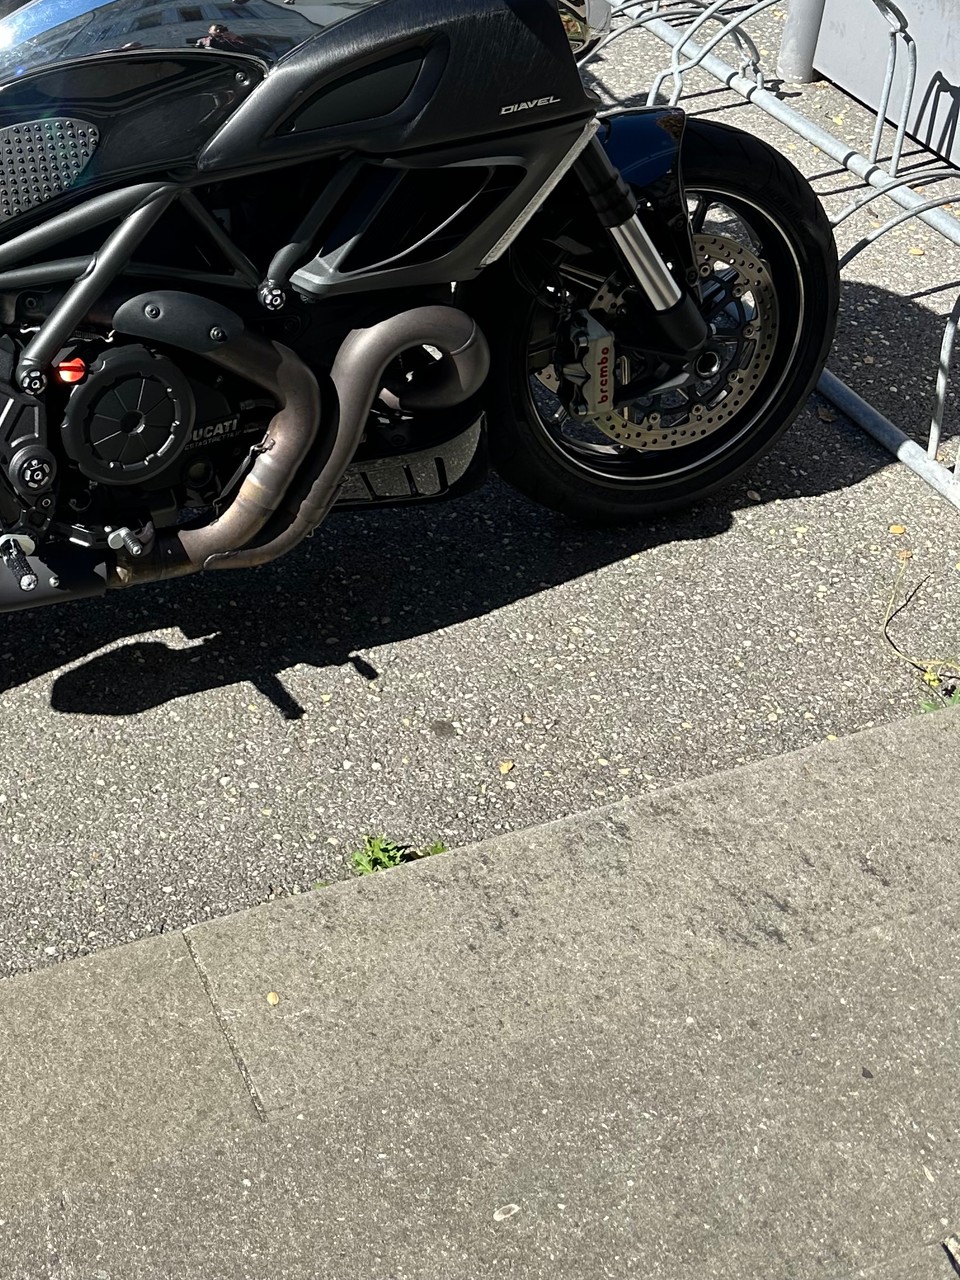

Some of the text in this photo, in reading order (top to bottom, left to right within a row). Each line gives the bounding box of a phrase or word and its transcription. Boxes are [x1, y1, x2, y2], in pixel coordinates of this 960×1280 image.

[499, 95, 561, 115] DIAVEL
[597, 346, 610, 405] brembo
[190, 418, 239, 442] UCATI
